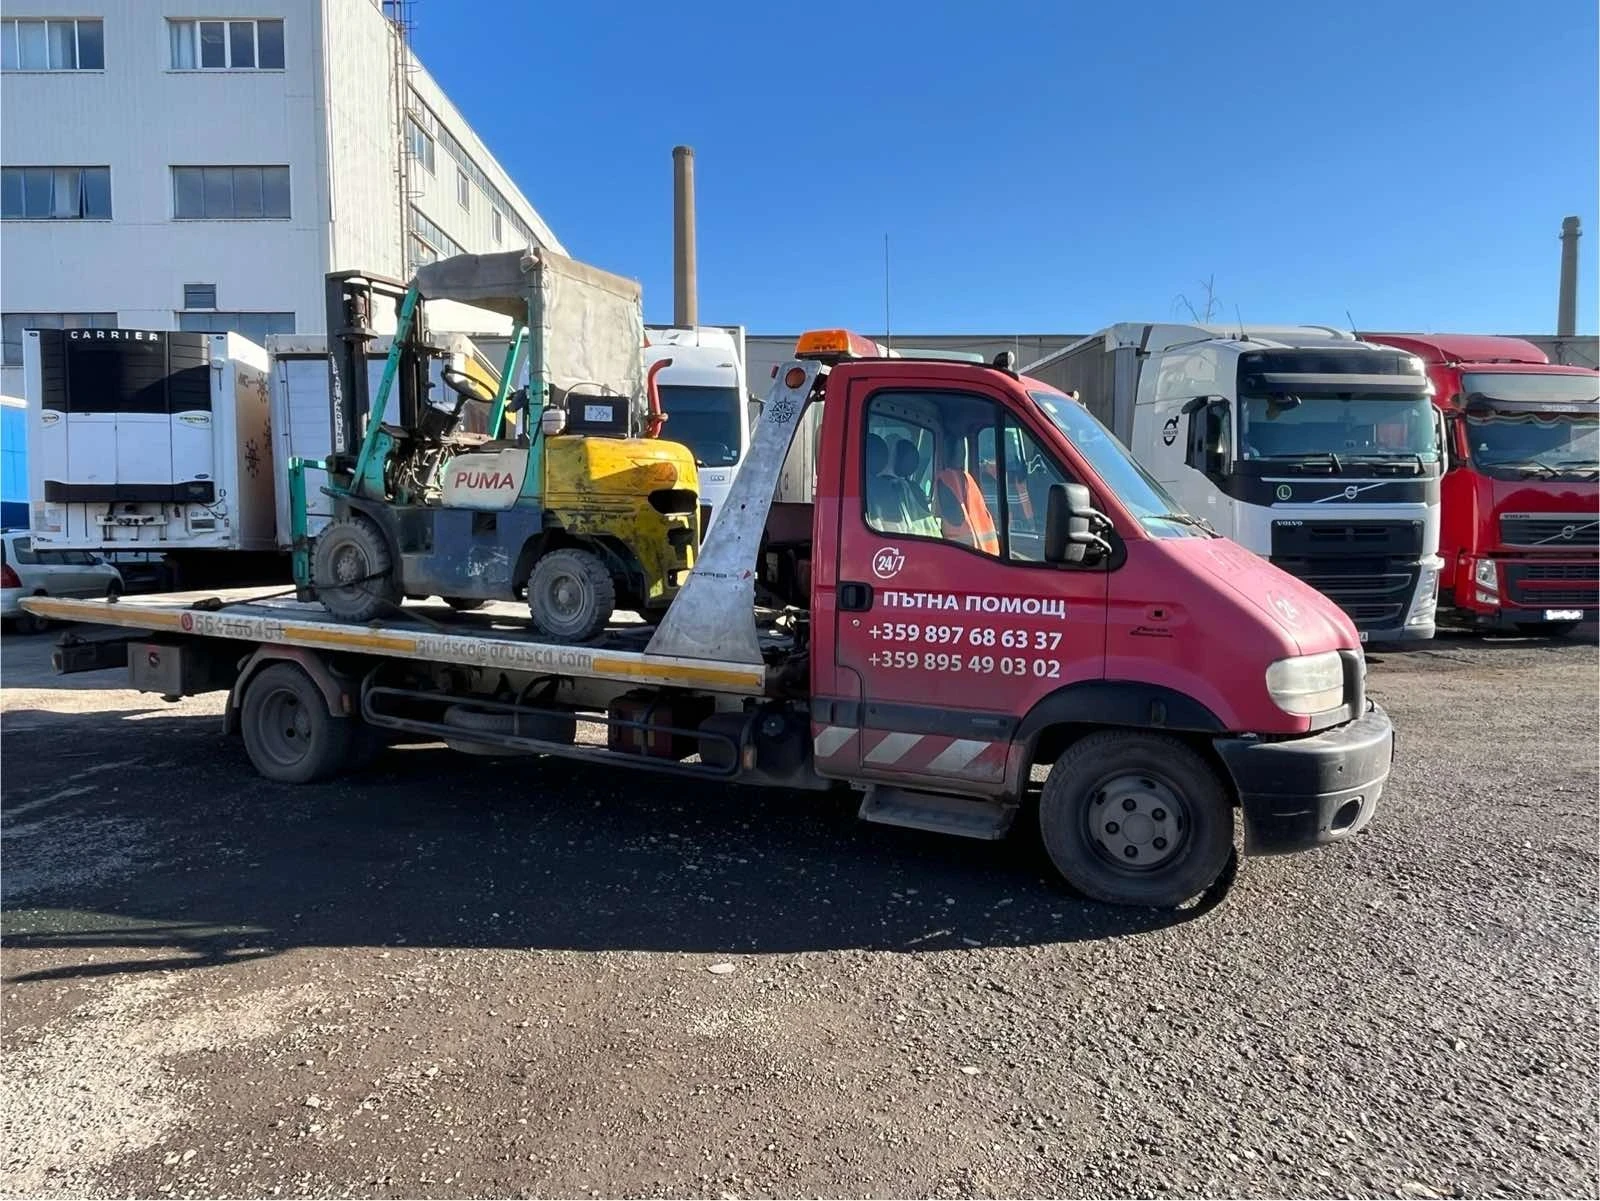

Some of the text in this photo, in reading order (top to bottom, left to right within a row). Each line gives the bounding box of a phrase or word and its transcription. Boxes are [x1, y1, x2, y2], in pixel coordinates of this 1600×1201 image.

[70, 330, 158, 341] CARRIER
[455, 472, 515, 489] PUMA
[877, 555, 905, 572] 24/7
[883, 591, 1066, 619] ПЪТНА ПОМОЩ
[869, 623, 1062, 651] +359 897 68 63 37
[868, 651, 1061, 678] +359 895 49 03 02
